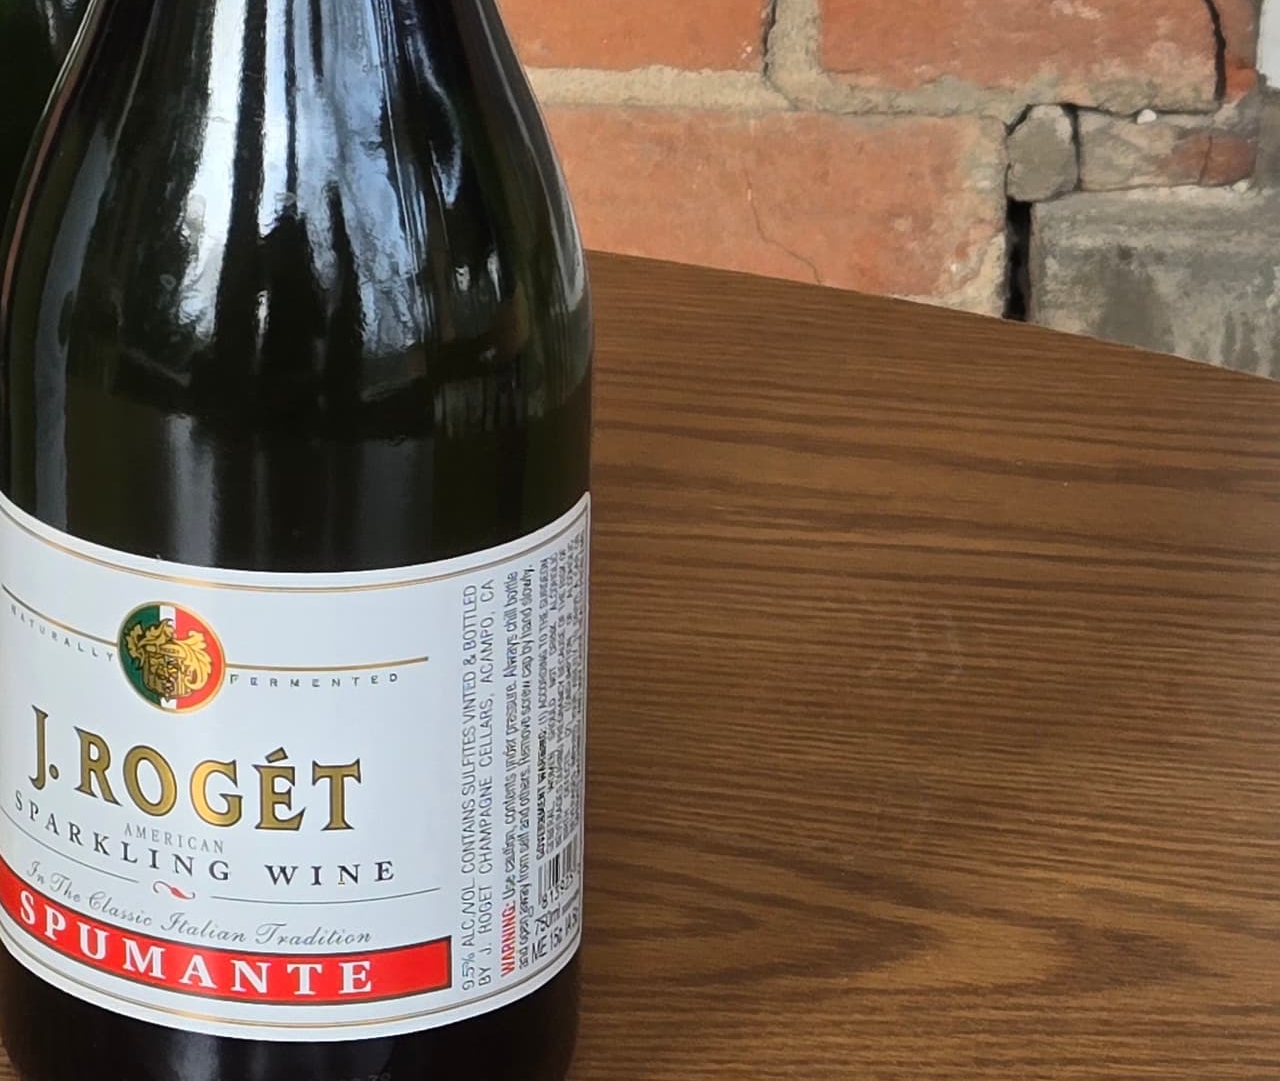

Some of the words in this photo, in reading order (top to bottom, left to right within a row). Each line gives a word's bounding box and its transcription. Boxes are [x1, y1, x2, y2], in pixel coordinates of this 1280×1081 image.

[463, 584, 476, 651] BOTTLED
[480, 579, 494, 603] CA
[9, 603, 114, 663] NATURALLY
[229, 672, 399, 688] FERMENTED
[463, 670, 476, 725] VINTED
[28, 703, 60, 791] J.
[73, 726, 362, 832] ROGÉT
[463, 725, 476, 796] SULFITES
[14, 789, 230, 882] SPARKLING
[264, 860, 394, 887] WINE
[123, 821, 225, 855] AMERICAN
[462, 798, 476, 874] CONTAINS
[478, 776, 493, 875] CHAMPAGNE
[26, 859, 46, 886] In
[49, 873, 82, 904] The
[88, 888, 153, 927] Classic
[160, 912, 247, 944] Italian
[254, 922, 373, 946] Tradition
[502, 901, 516, 977] WARNING:
[18, 890, 374, 996] SPUMANTE
[478, 966, 492, 987] BY
